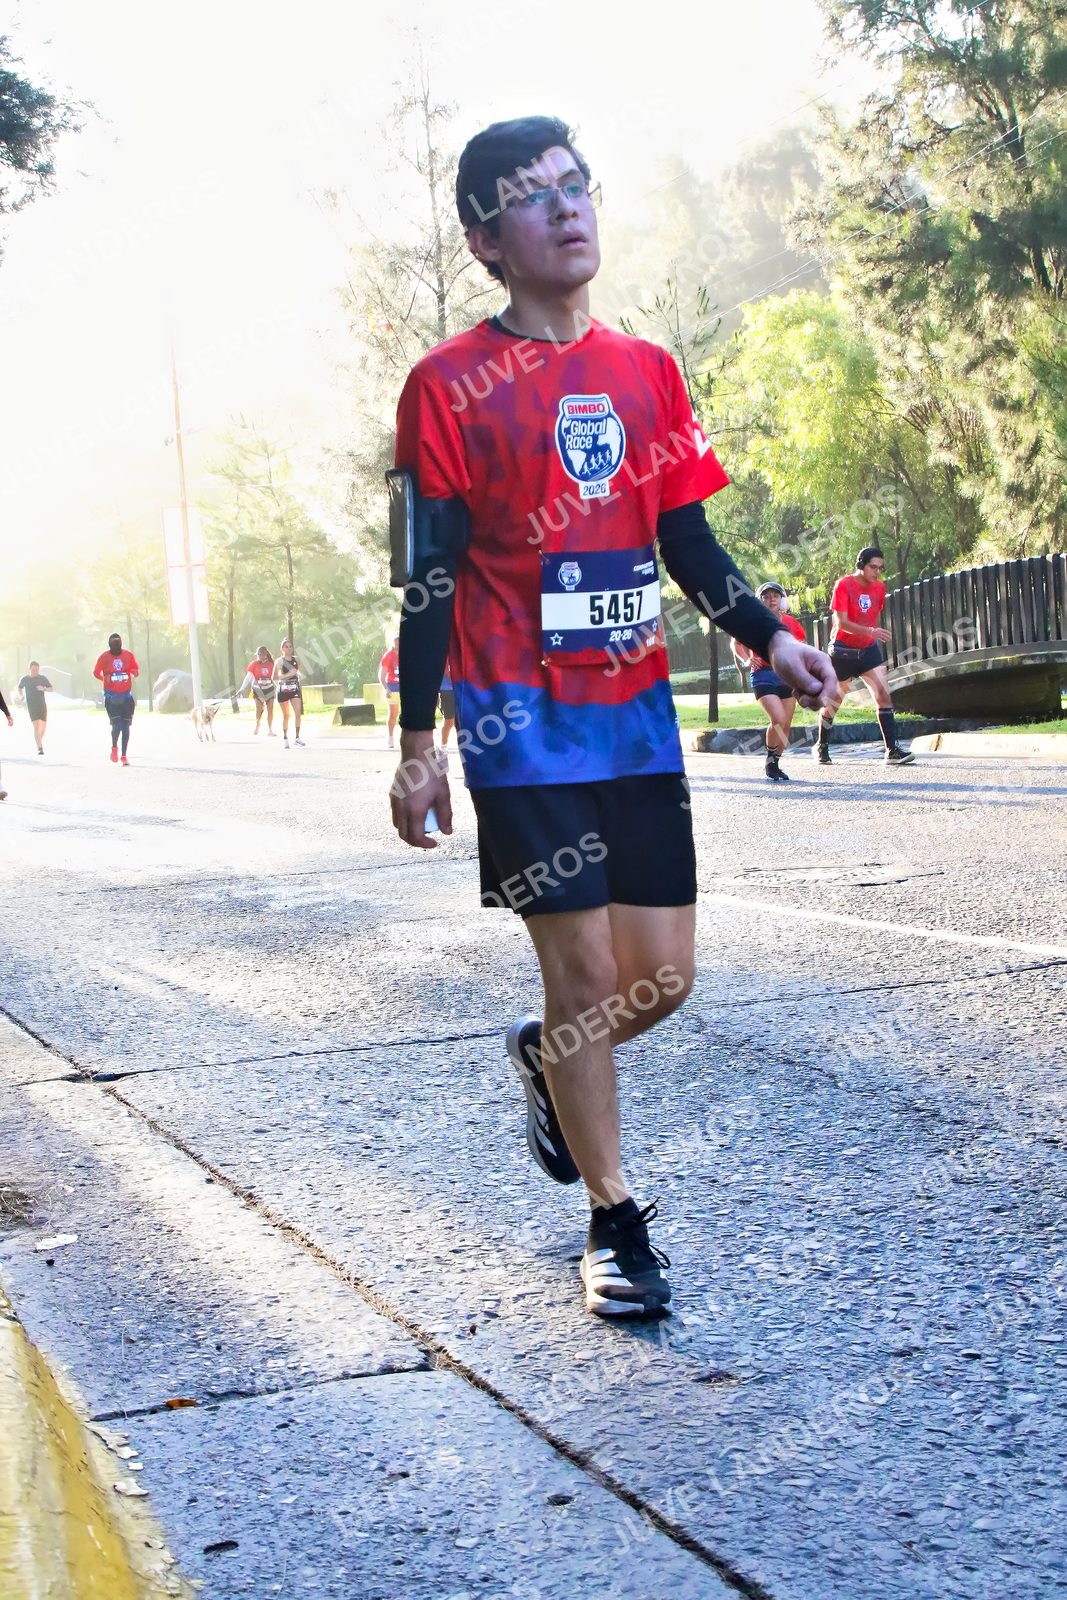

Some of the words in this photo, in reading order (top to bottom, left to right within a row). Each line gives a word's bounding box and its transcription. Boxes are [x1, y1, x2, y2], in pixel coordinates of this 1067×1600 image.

[567, 403, 605, 414] BIMBO
[570, 419, 607, 436] Global
[565, 434, 593, 450] Race
[583, 483, 607, 496] 2026
[589, 590, 643, 626] 5457
